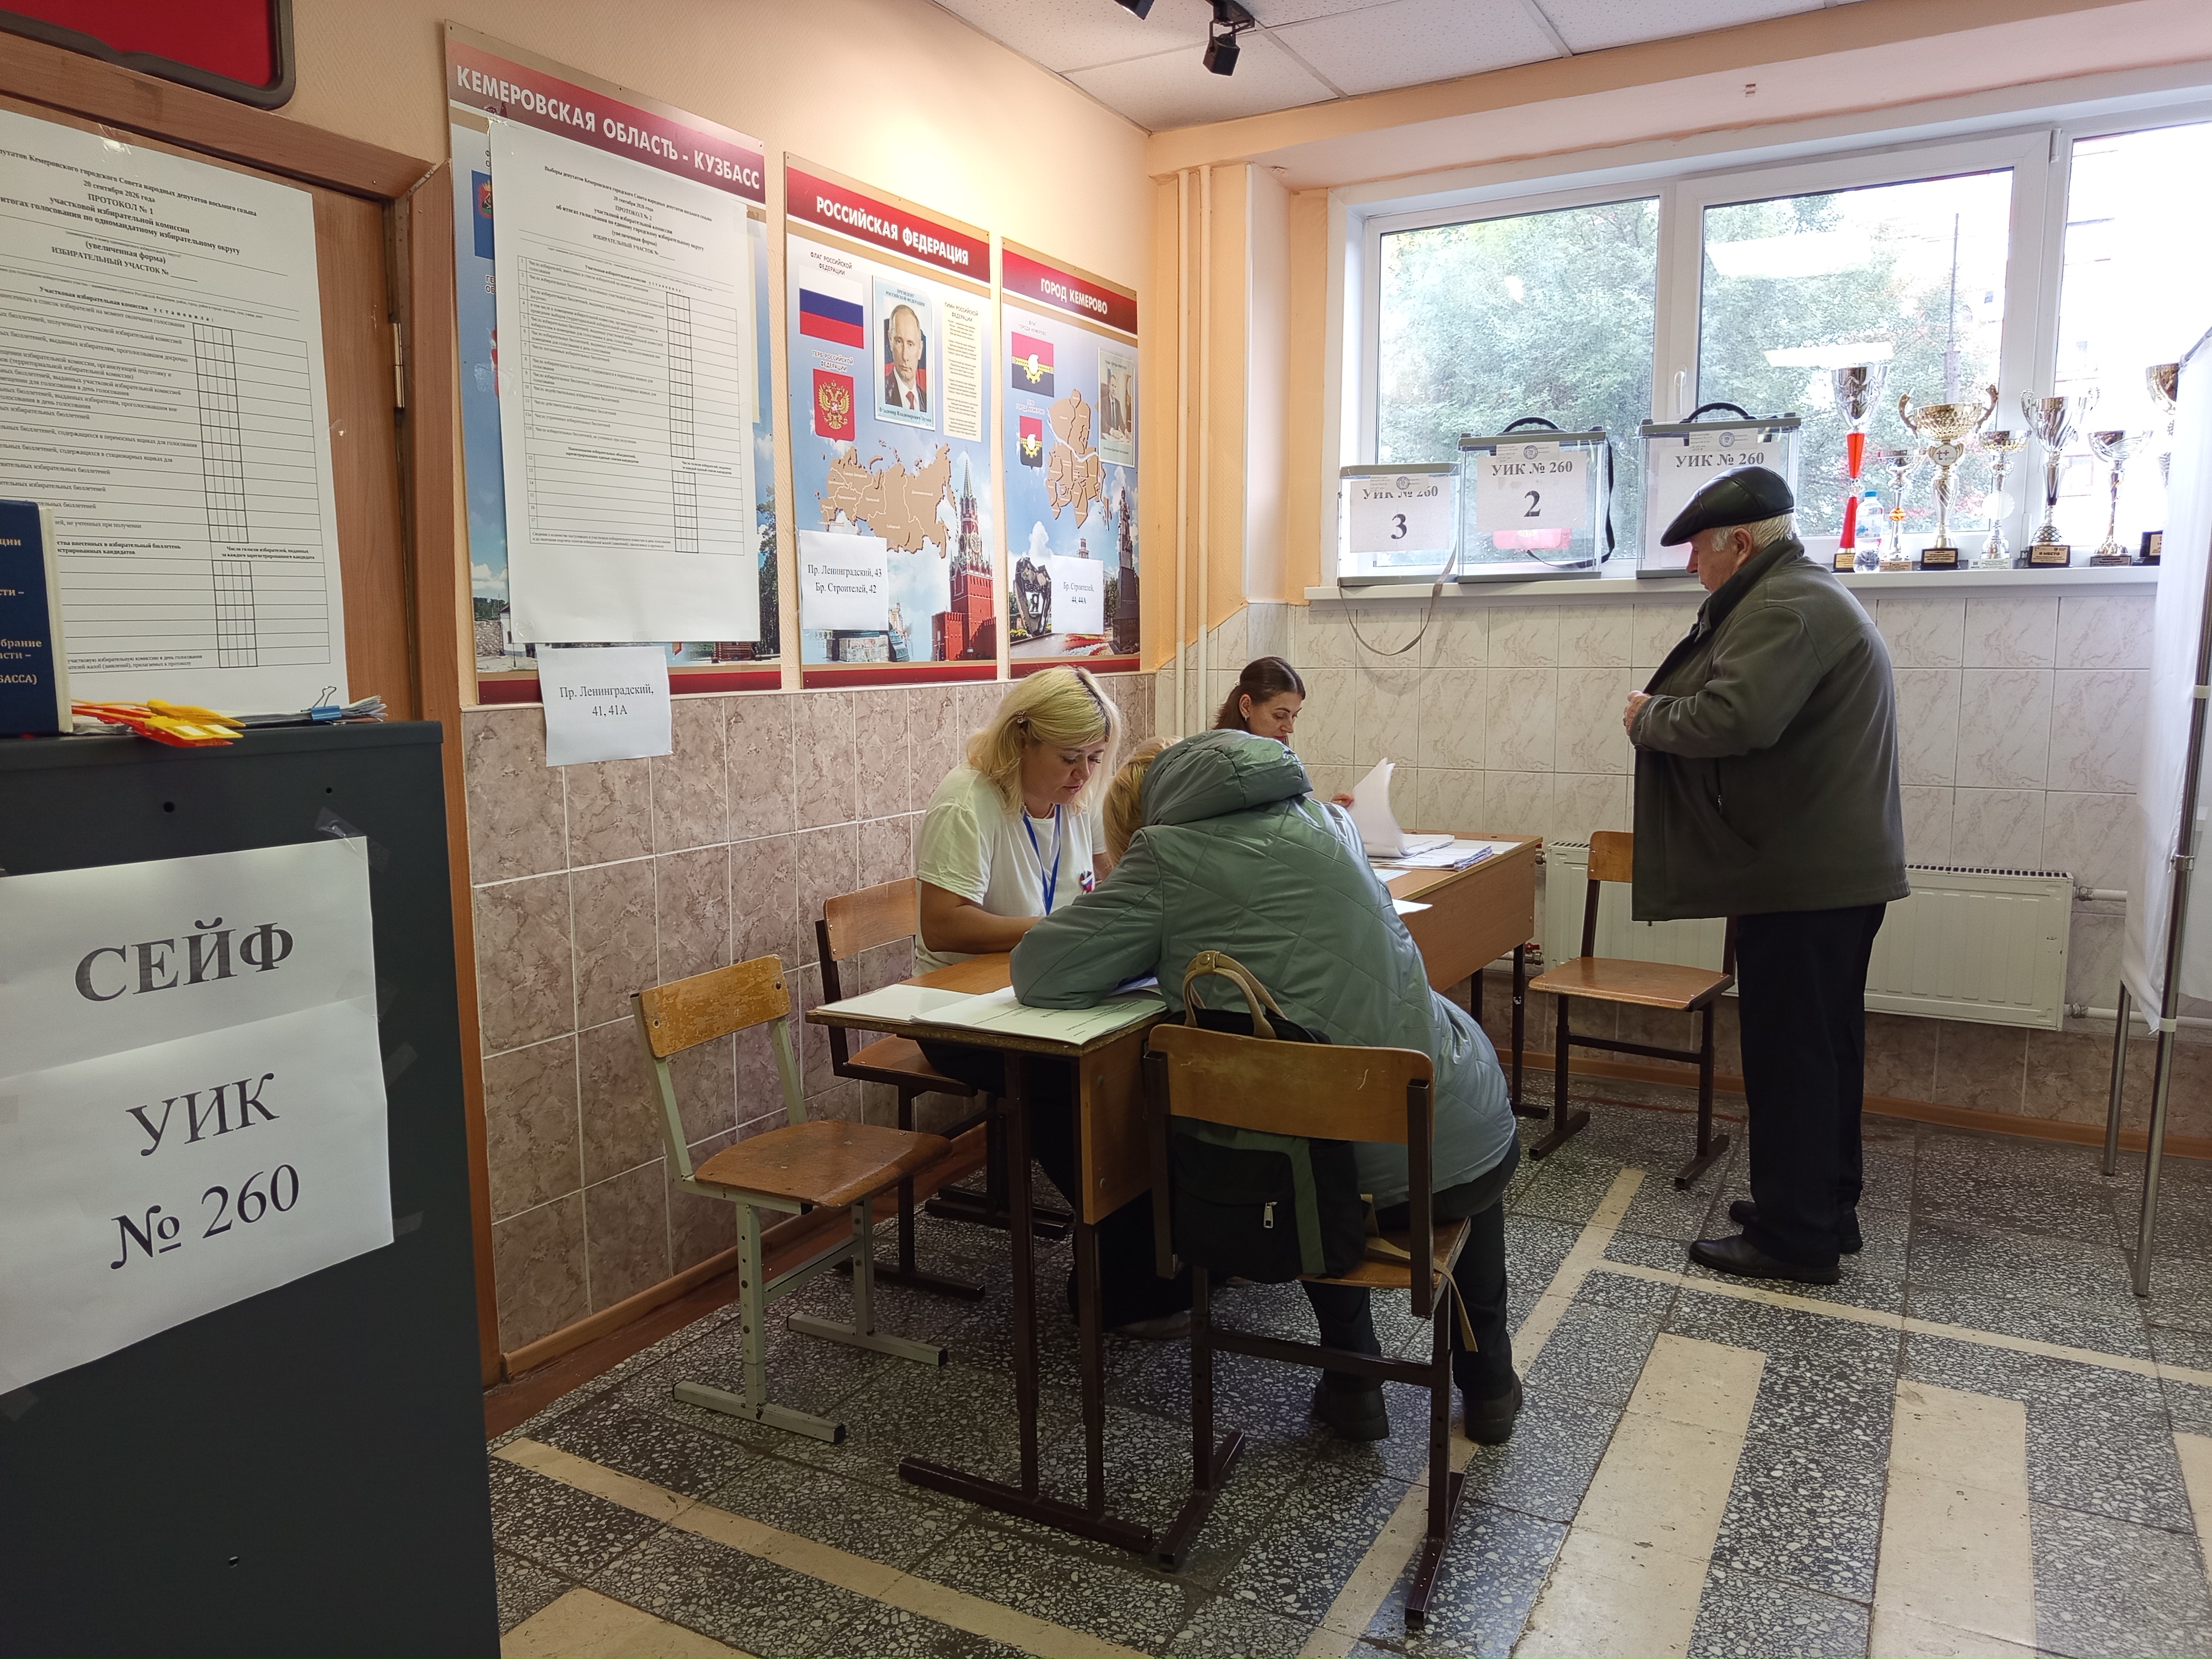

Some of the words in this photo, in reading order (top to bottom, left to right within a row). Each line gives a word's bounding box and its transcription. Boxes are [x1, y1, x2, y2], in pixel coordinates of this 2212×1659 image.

[457, 65, 596, 132] КЕМЕРОВСКАЯ
[603, 119, 679, 160] ОБЛАСТЬ
[694, 150, 760, 189] КУЗБАСС
[92, 184, 124, 195] сентября
[124, 190, 140, 199] 2026
[87, 193, 137, 211] ПРОТОКОЛ
[49, 197, 96, 212] участковой
[96, 208, 154, 226] избирательной
[155, 221, 190, 234] комиссии
[0, 197, 29, 207] итогах
[30, 203, 82, 219] голосования
[94, 217, 158, 237] одномандатному
[159, 232, 216, 250] избирательному
[217, 245, 241, 255] округу
[816, 196, 899, 241] РОССИЙСКАЯ
[902, 227, 968, 265] ФЕДЕРАЦИЯ
[51, 247, 123, 266] ИЗБИРАТЕЛЬНЫЙ
[124, 261, 160, 274] УЧАСТОК
[85, 241, 138, 257] (увеличенная
[139, 252, 166, 264] форма)
[819, 263, 845, 275] ФЕДЕРАЦИИ
[823, 255, 852, 269] РОССИЙСКОЙ
[1041, 278, 1067, 303] ГОРОД
[1070, 289, 1108, 315] КЕМЕРОВО
[952, 312, 973, 322] ФЕДЕРАЦИИ
[956, 305, 978, 316] РОССИЙСКОЙ
[821, 361, 847, 371] ФЕДЕРАЦИИ
[825, 353, 853, 364] РОССИЙСКОЙ
[1676, 455, 1713, 467] УИК
[1717, 454, 1734, 466] №
[1739, 452, 1764, 465] 260
[1491, 463, 1525, 476] УИК
[1530, 463, 1545, 474] №
[1550, 461, 1573, 473] 260
[1524, 491, 1541, 517] 2
[1391, 514, 1407, 539] 3
[807, 564, 820, 578] Пр.
[822, 565, 873, 578] Ленинградский,
[874, 568, 882, 577] 43
[815, 582, 826, 593] Бр.
[828, 582, 868, 594] Строителей,
[869, 585, 877, 593] 42
[1071, 582, 1094, 592] Строителей,
[559, 686, 577, 700] Пр.
[580, 684, 654, 698] Ленинградский,
[592, 706, 607, 718] 41,
[608, 704, 628, 716] 41А
[74, 917, 294, 1001] СЕЙФ
[126, 1072, 280, 1156] УИК
[110, 1204, 182, 1270] №
[201, 1164, 300, 1238] 260
